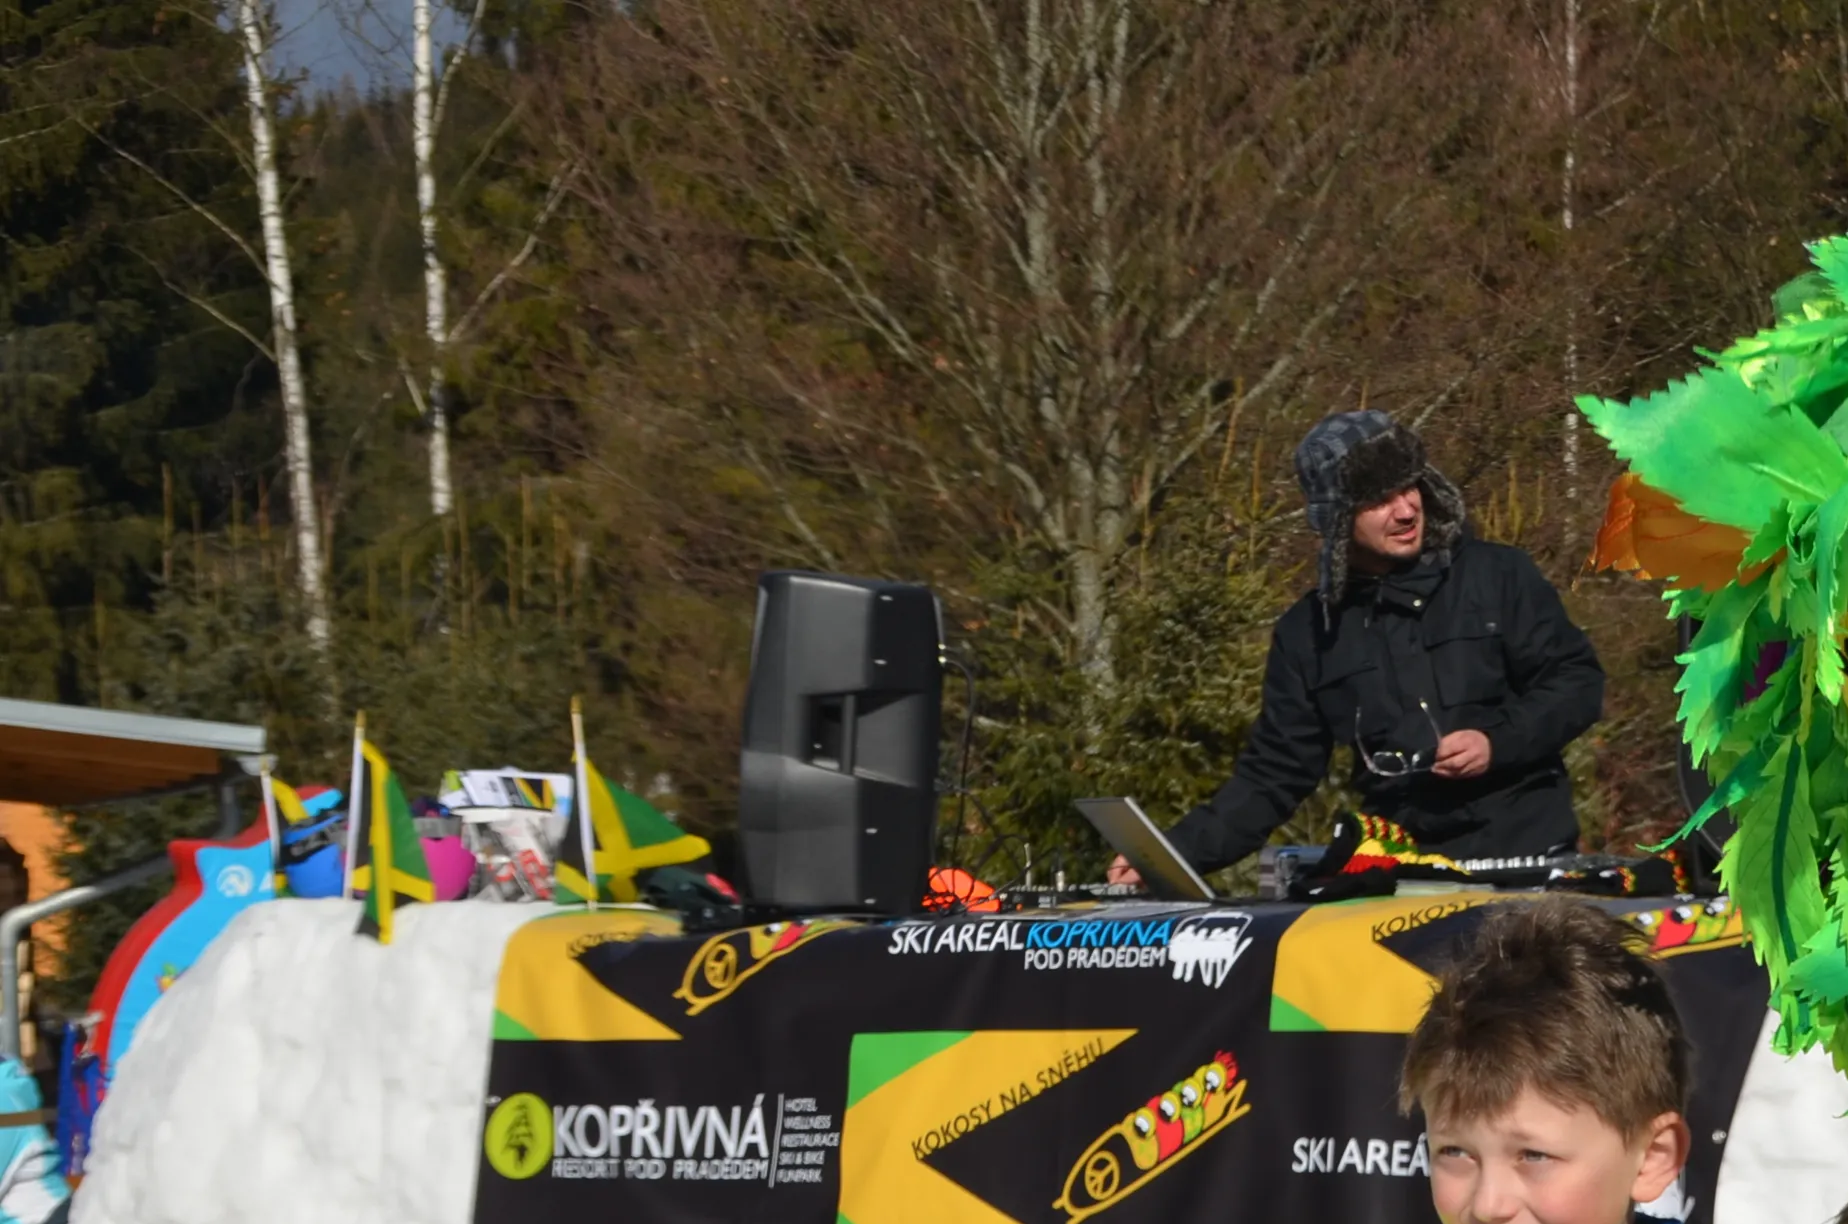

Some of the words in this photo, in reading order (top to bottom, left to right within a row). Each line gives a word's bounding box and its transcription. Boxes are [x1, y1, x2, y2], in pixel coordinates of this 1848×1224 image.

[888, 926, 935, 954] SKI
[1024, 948, 1063, 970] POD
[911, 1098, 992, 1161] KOKOSY
[999, 1081, 1033, 1114] NA
[1036, 1037, 1104, 1091] SNĚHU
[553, 1093, 769, 1158] KOPŘIVNÁ
[552, 1158, 620, 1178] RESORT
[624, 1159, 666, 1180] POD
[1292, 1137, 1335, 1173] SKI
[1337, 1132, 1431, 1177] AREÁ
